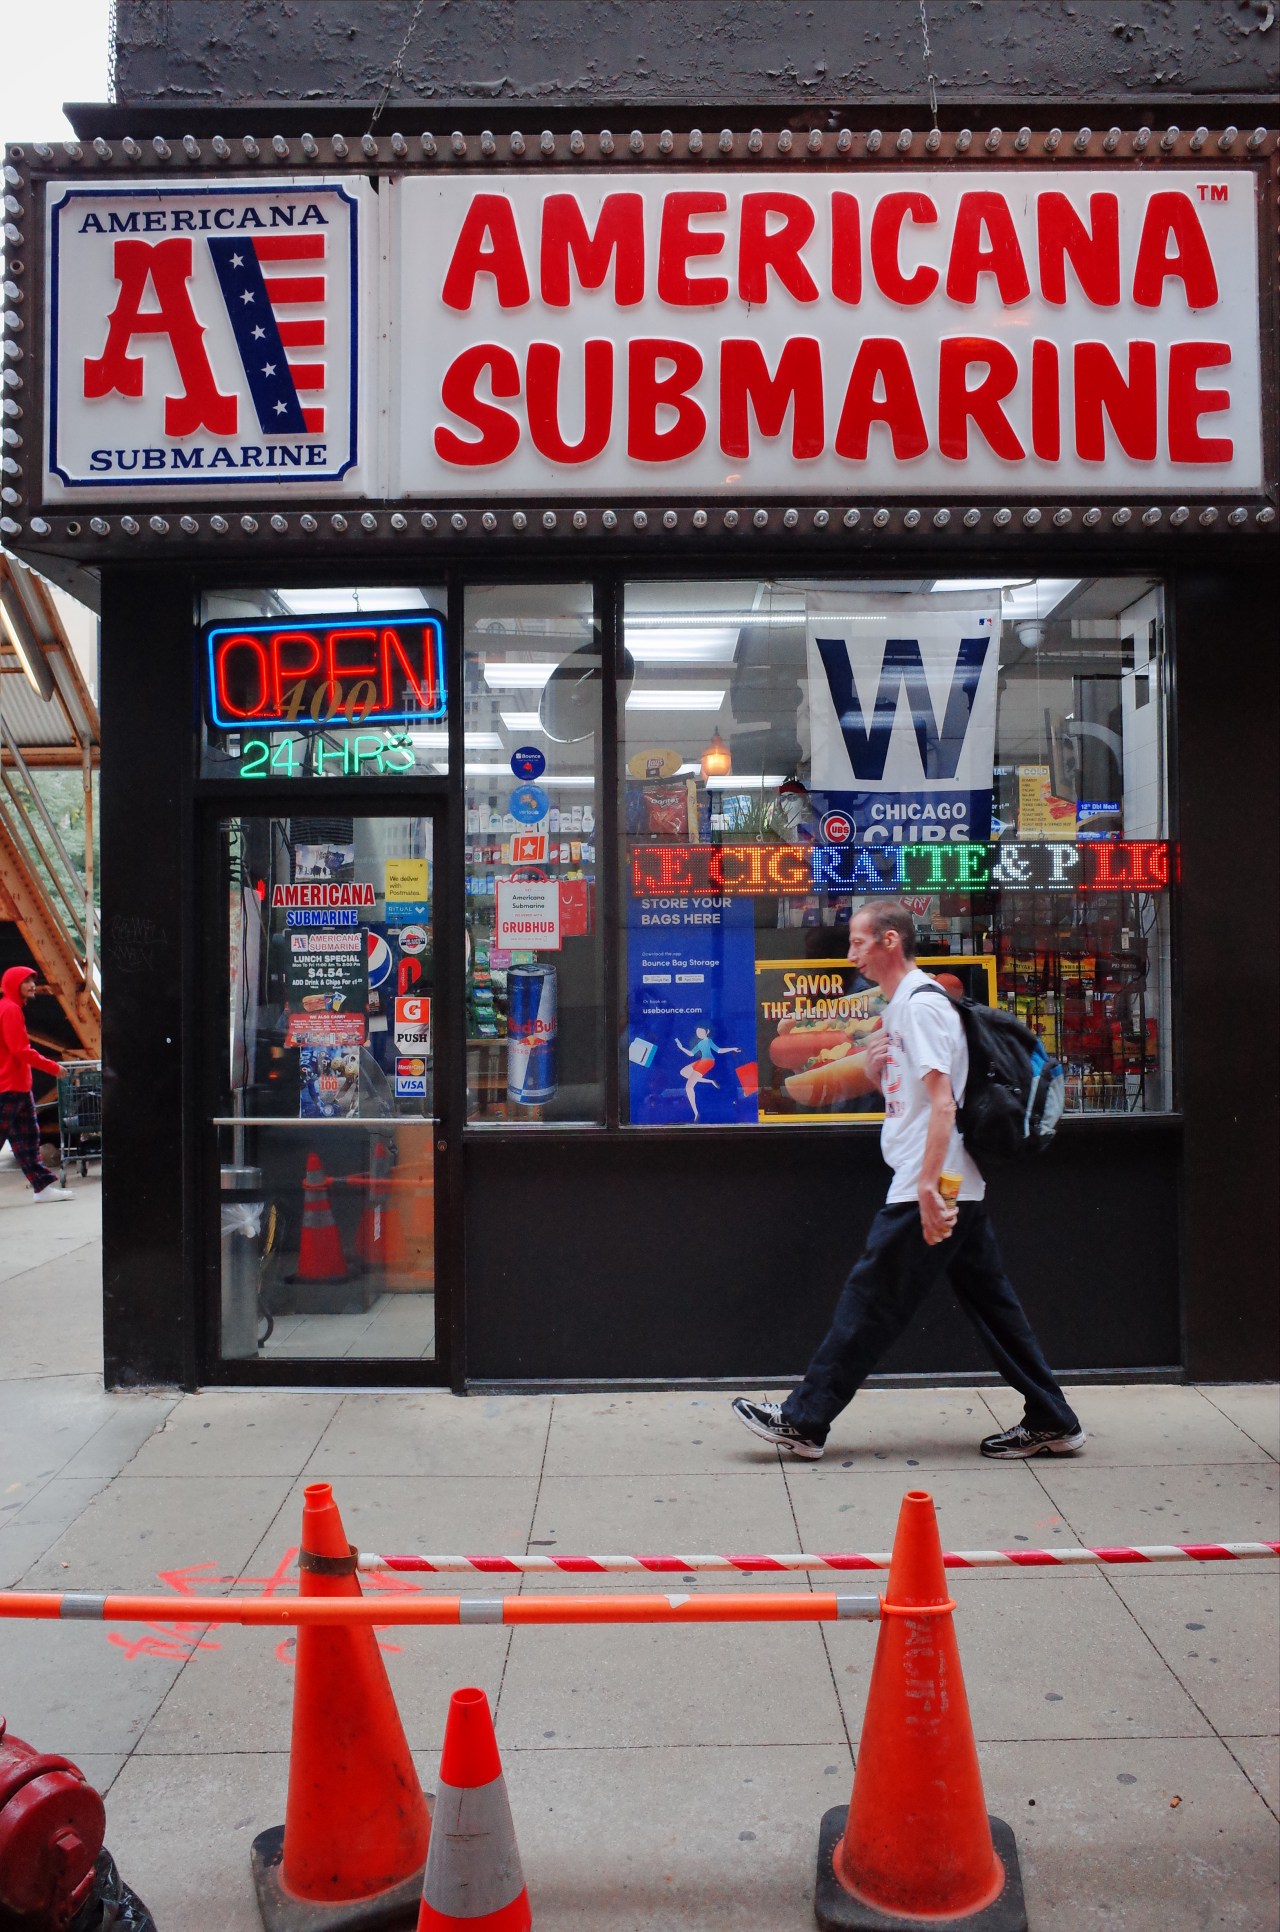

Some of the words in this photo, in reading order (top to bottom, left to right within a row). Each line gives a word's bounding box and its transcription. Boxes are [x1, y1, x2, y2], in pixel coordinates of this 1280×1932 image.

[78, 204, 330, 234] AMERICANA
[442, 190, 1219, 310] AMERICANA
[434, 336, 1234, 467] SUBMARINE
[89, 445, 328, 473] SUBMARINE
[217, 626, 434, 717] OPEN
[273, 679, 377, 724] 400
[816, 637, 990, 780] W
[240, 738, 300, 778] 24
[317, 734, 416, 776] HRS
[871, 802, 967, 820] CHICAGO
[273, 884, 375, 906] AMERICANA
[642, 898, 688, 909] STORE
[692, 898, 732, 908] YOUR
[288, 910, 358, 924] SUBMARINE
[642, 914, 681, 925] BAGS
[684, 913, 721, 924] HERE
[502, 922, 554, 933] GRUBHUB
[672, 960, 687, 968] Bag
[690, 959, 720, 967] Storage
[308, 968, 343, 978] $4.54
[403, 1000, 421, 1020] G
[761, 1002, 791, 1020] THE
[508, 1016, 532, 1034] Red
[534, 1016, 556, 1033] Bull
[397, 1034, 427, 1043] PUSH
[321, 1081, 338, 1090] 100
[400, 1080, 423, 1089] VISA
